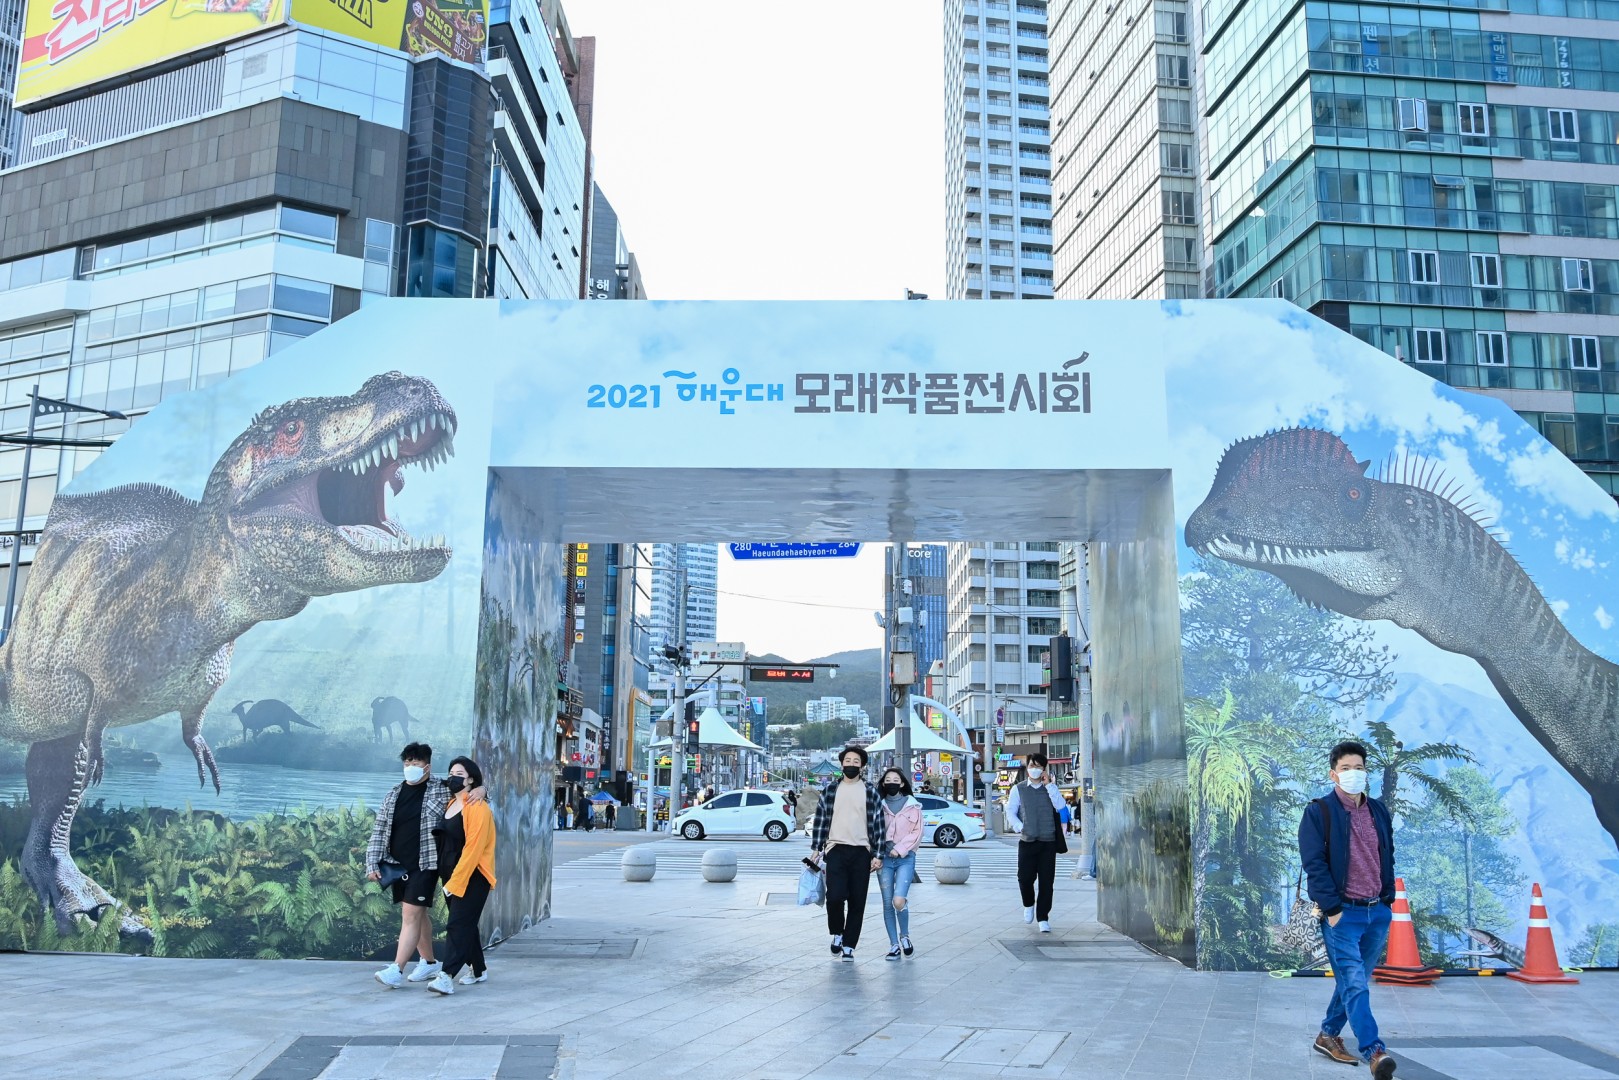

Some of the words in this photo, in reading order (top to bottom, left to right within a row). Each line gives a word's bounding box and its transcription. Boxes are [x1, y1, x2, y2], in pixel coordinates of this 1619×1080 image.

[425, 6, 454, 38] UNO
[587, 384, 661, 409] 2021
[662, 367, 784, 415] 해운대
[794, 350, 1091, 414] 모래작품전시회
[752, 548, 837, 557] Haeundaehaebyeon-ro
